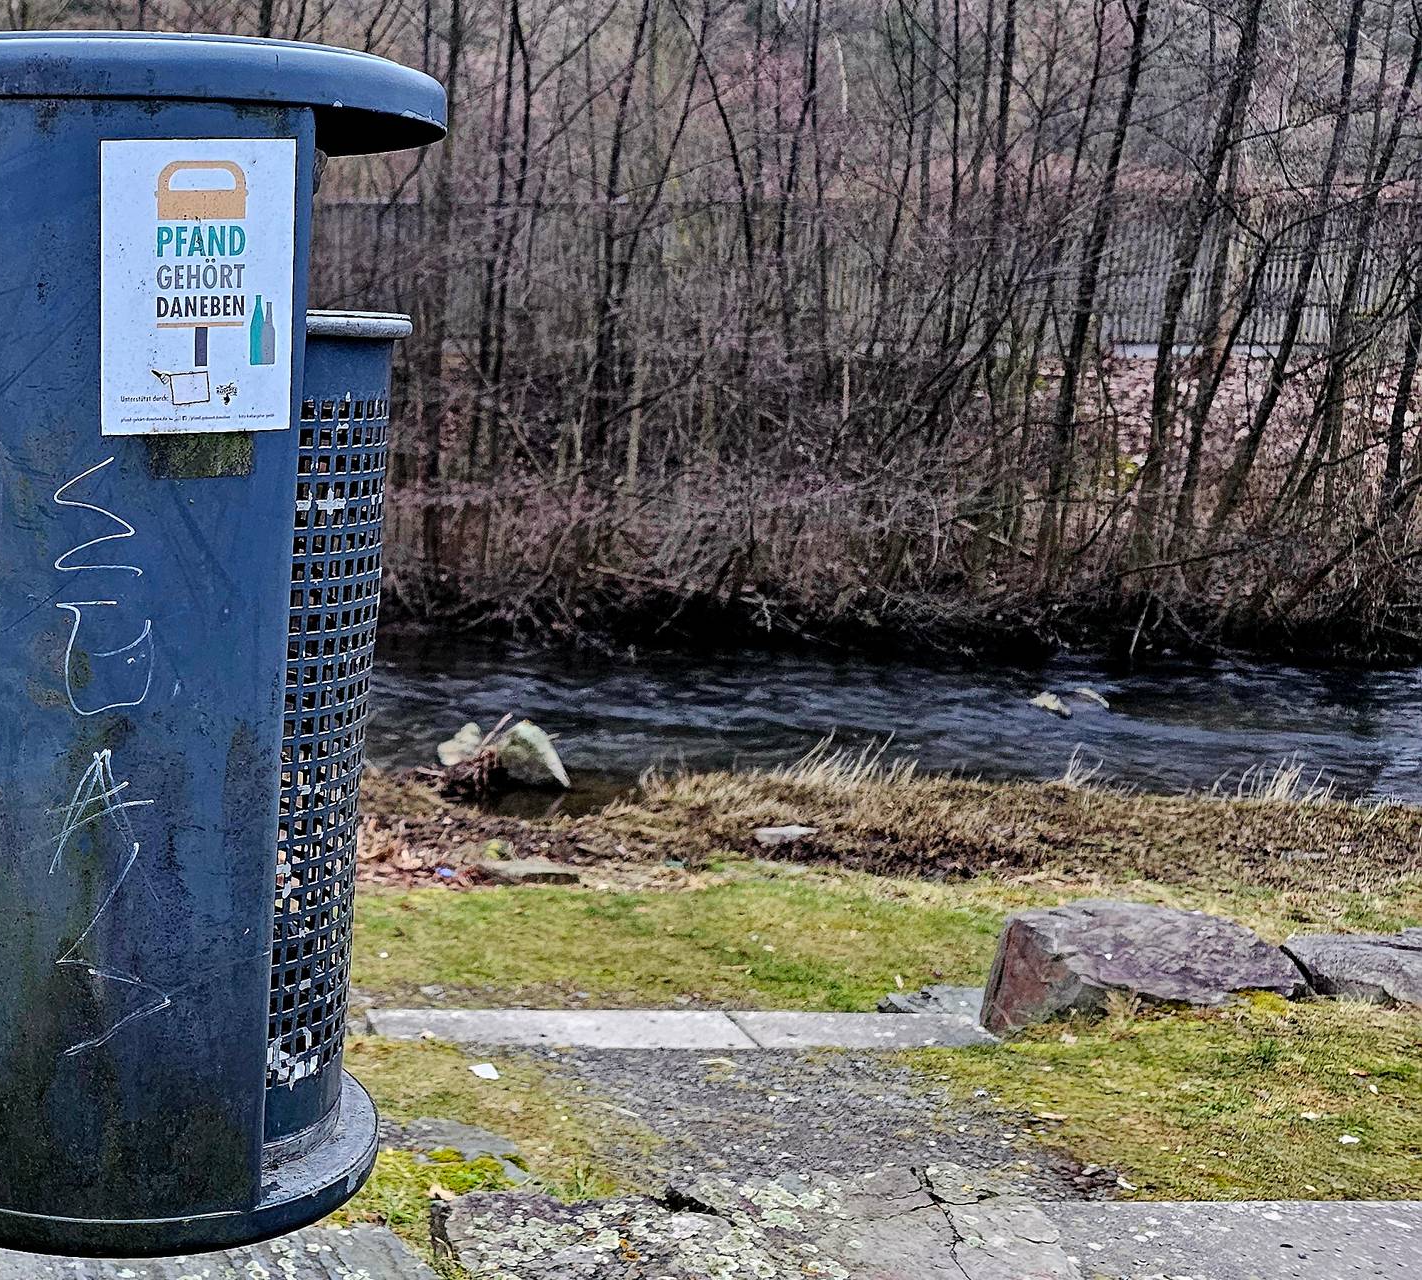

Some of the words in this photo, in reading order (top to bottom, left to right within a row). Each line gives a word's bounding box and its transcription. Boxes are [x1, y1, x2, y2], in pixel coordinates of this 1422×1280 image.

[156, 225, 246, 258] PFAND
[156, 258, 245, 290] GEHÖRT
[156, 295, 245, 318] DANEBEN
